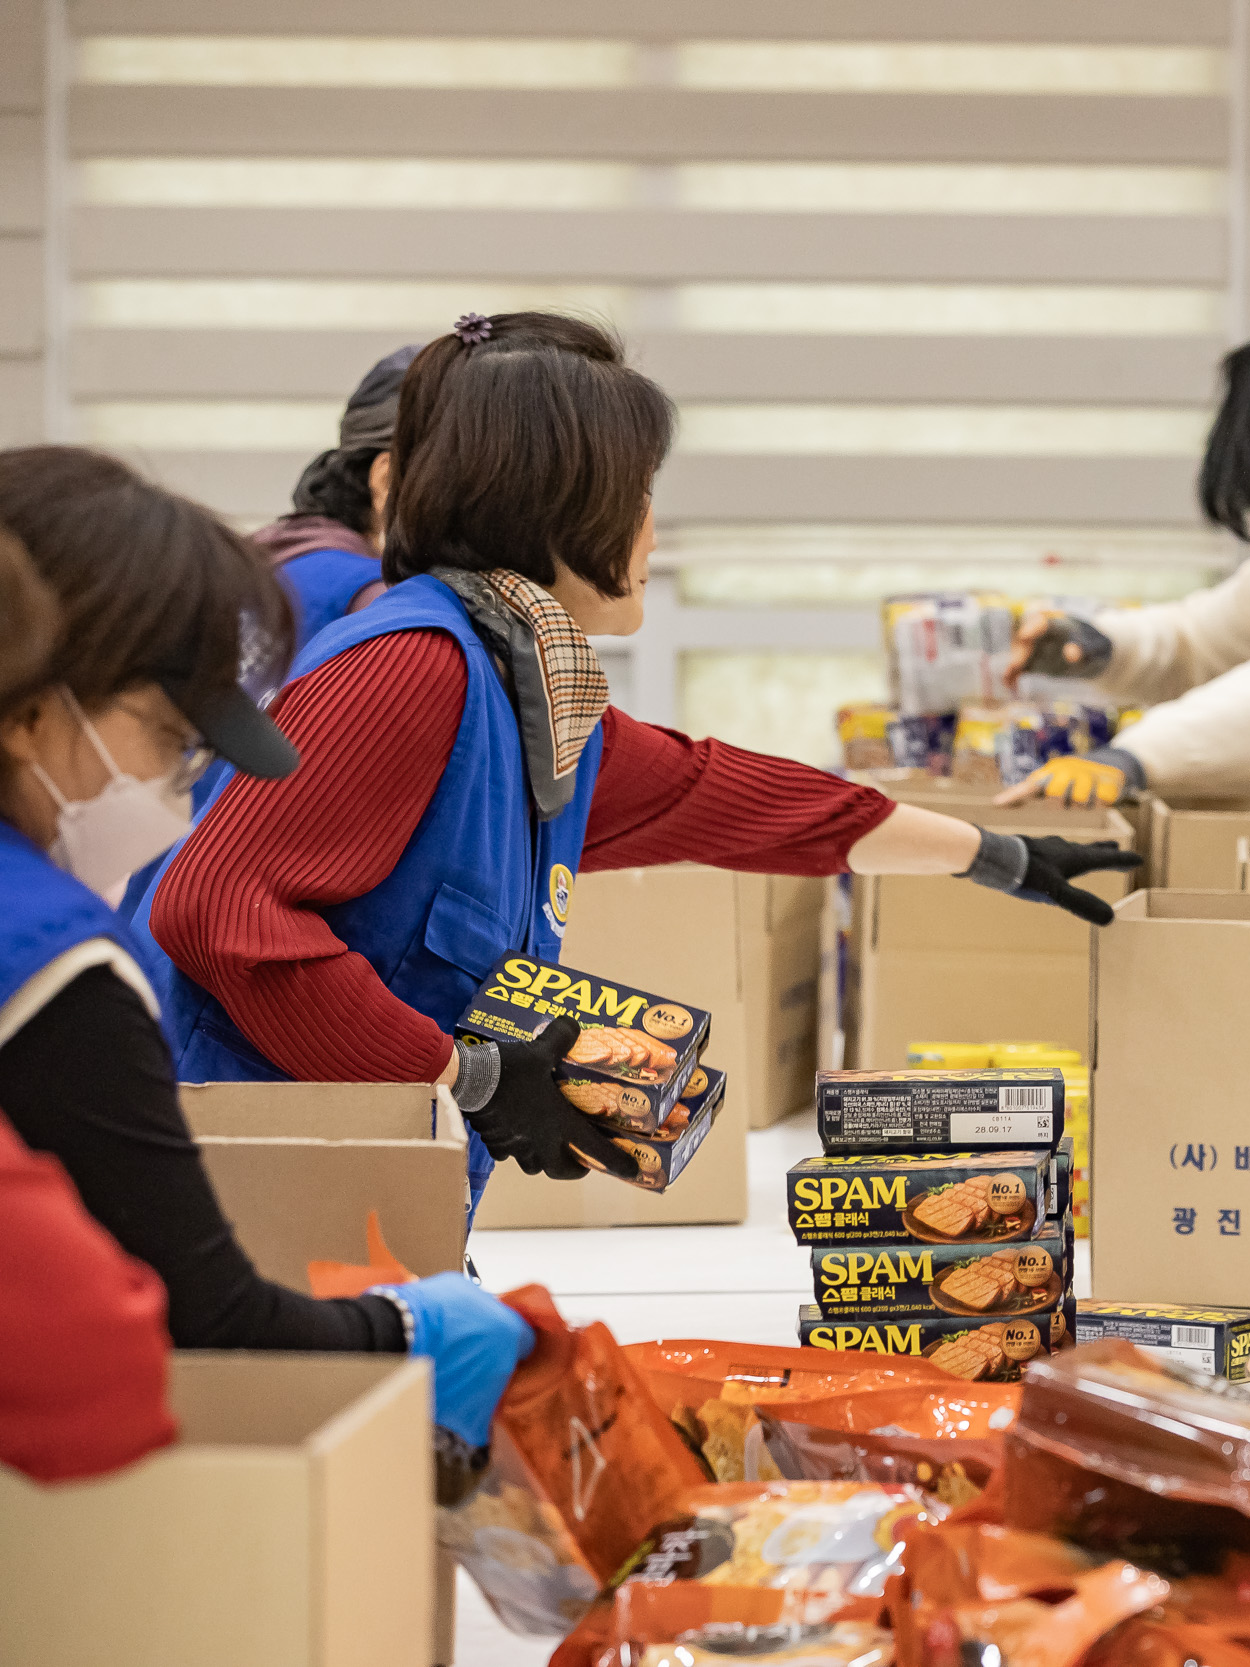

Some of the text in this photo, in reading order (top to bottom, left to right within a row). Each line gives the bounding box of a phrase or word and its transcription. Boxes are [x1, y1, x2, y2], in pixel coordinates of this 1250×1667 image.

[485, 986, 535, 1009] 스팸
[496, 959, 648, 1026] SPAM
[975, 1126, 1012, 1134] 28.09.17
[1169, 1143, 1217, 1171] (사)
[794, 1176, 908, 1211] SPAM
[991, 1183, 1020, 1194] No.1
[796, 1211, 870, 1228] 스팸 클래식
[820, 1250, 934, 1286] SPAM
[1018, 1256, 1047, 1267] No.1
[822, 1286, 896, 1302] 스팸 클래식
[809, 1324, 922, 1356] SPAM
[1006, 1329, 1035, 1341] No.1
